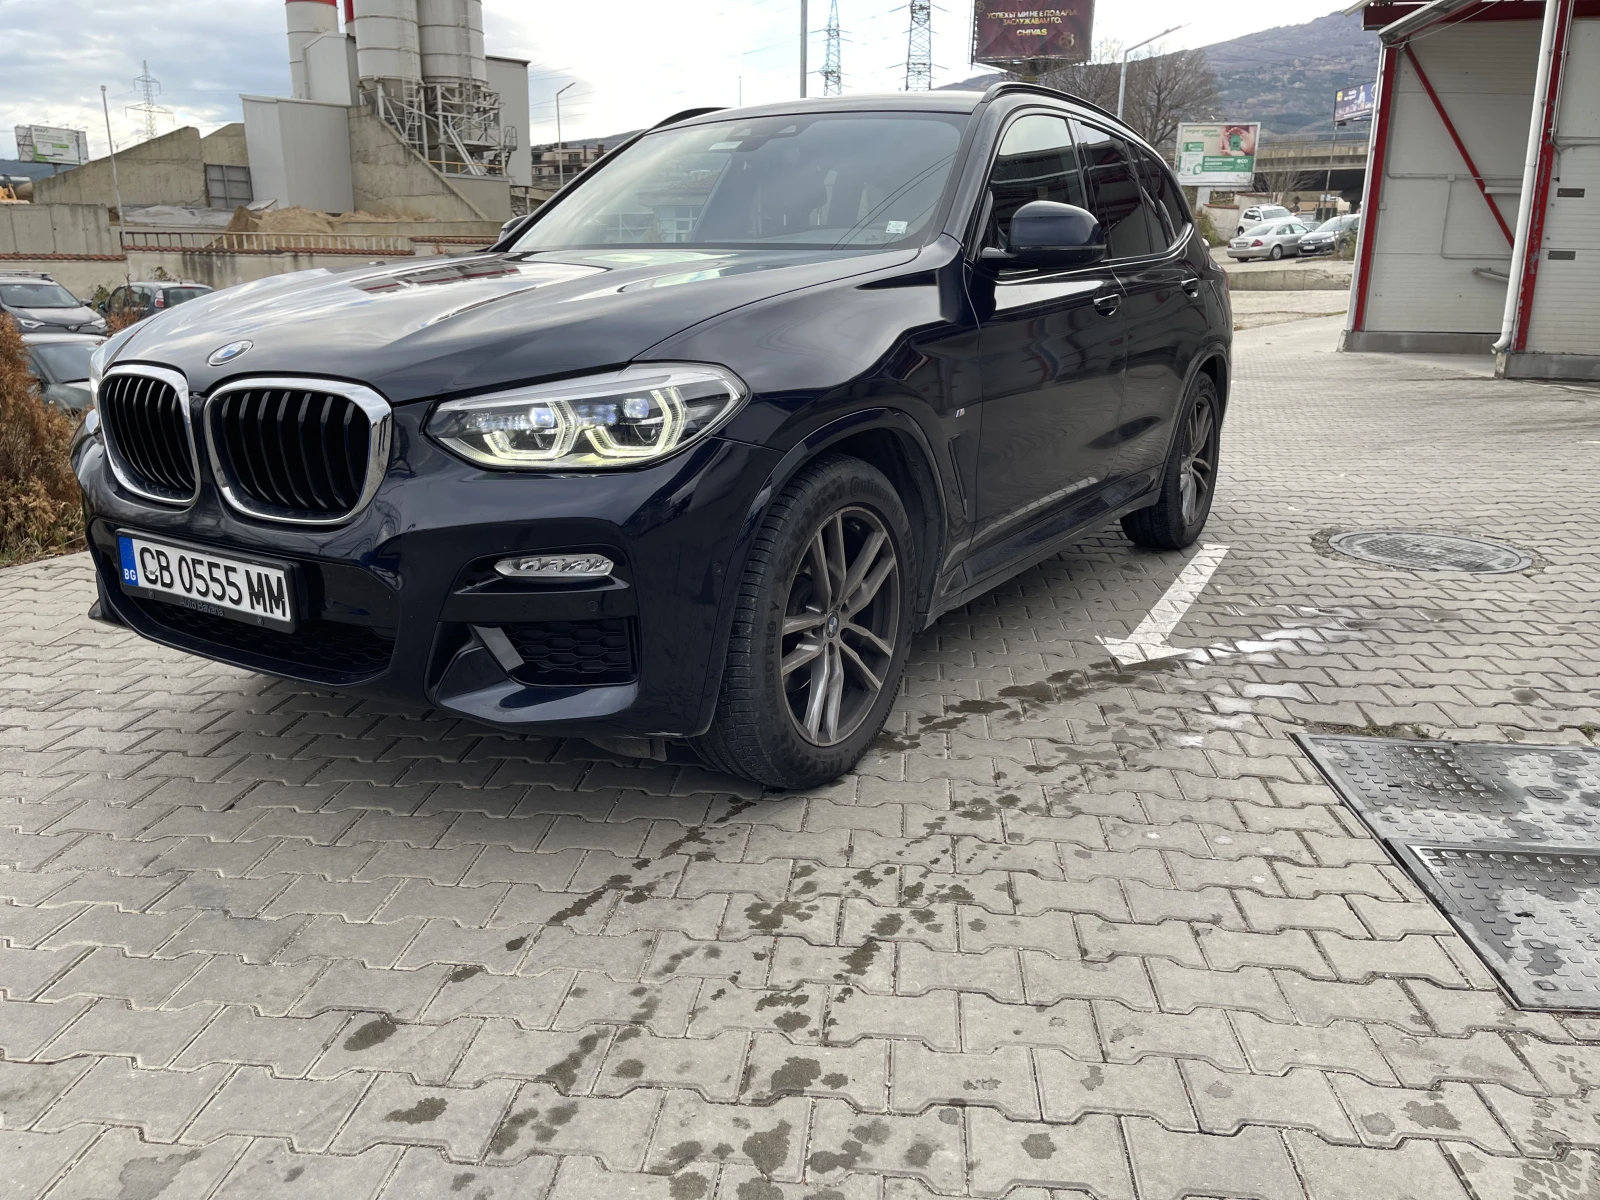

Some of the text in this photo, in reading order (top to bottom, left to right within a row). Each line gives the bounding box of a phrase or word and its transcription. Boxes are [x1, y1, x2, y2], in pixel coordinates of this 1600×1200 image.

[1003, 17, 1050, 25] ЗАСЛУЖАВАМ
[1016, 28, 1047, 36] CHIVAS
[123, 568, 137, 581] BG
[140, 546, 286, 618] CB 0555 MM
